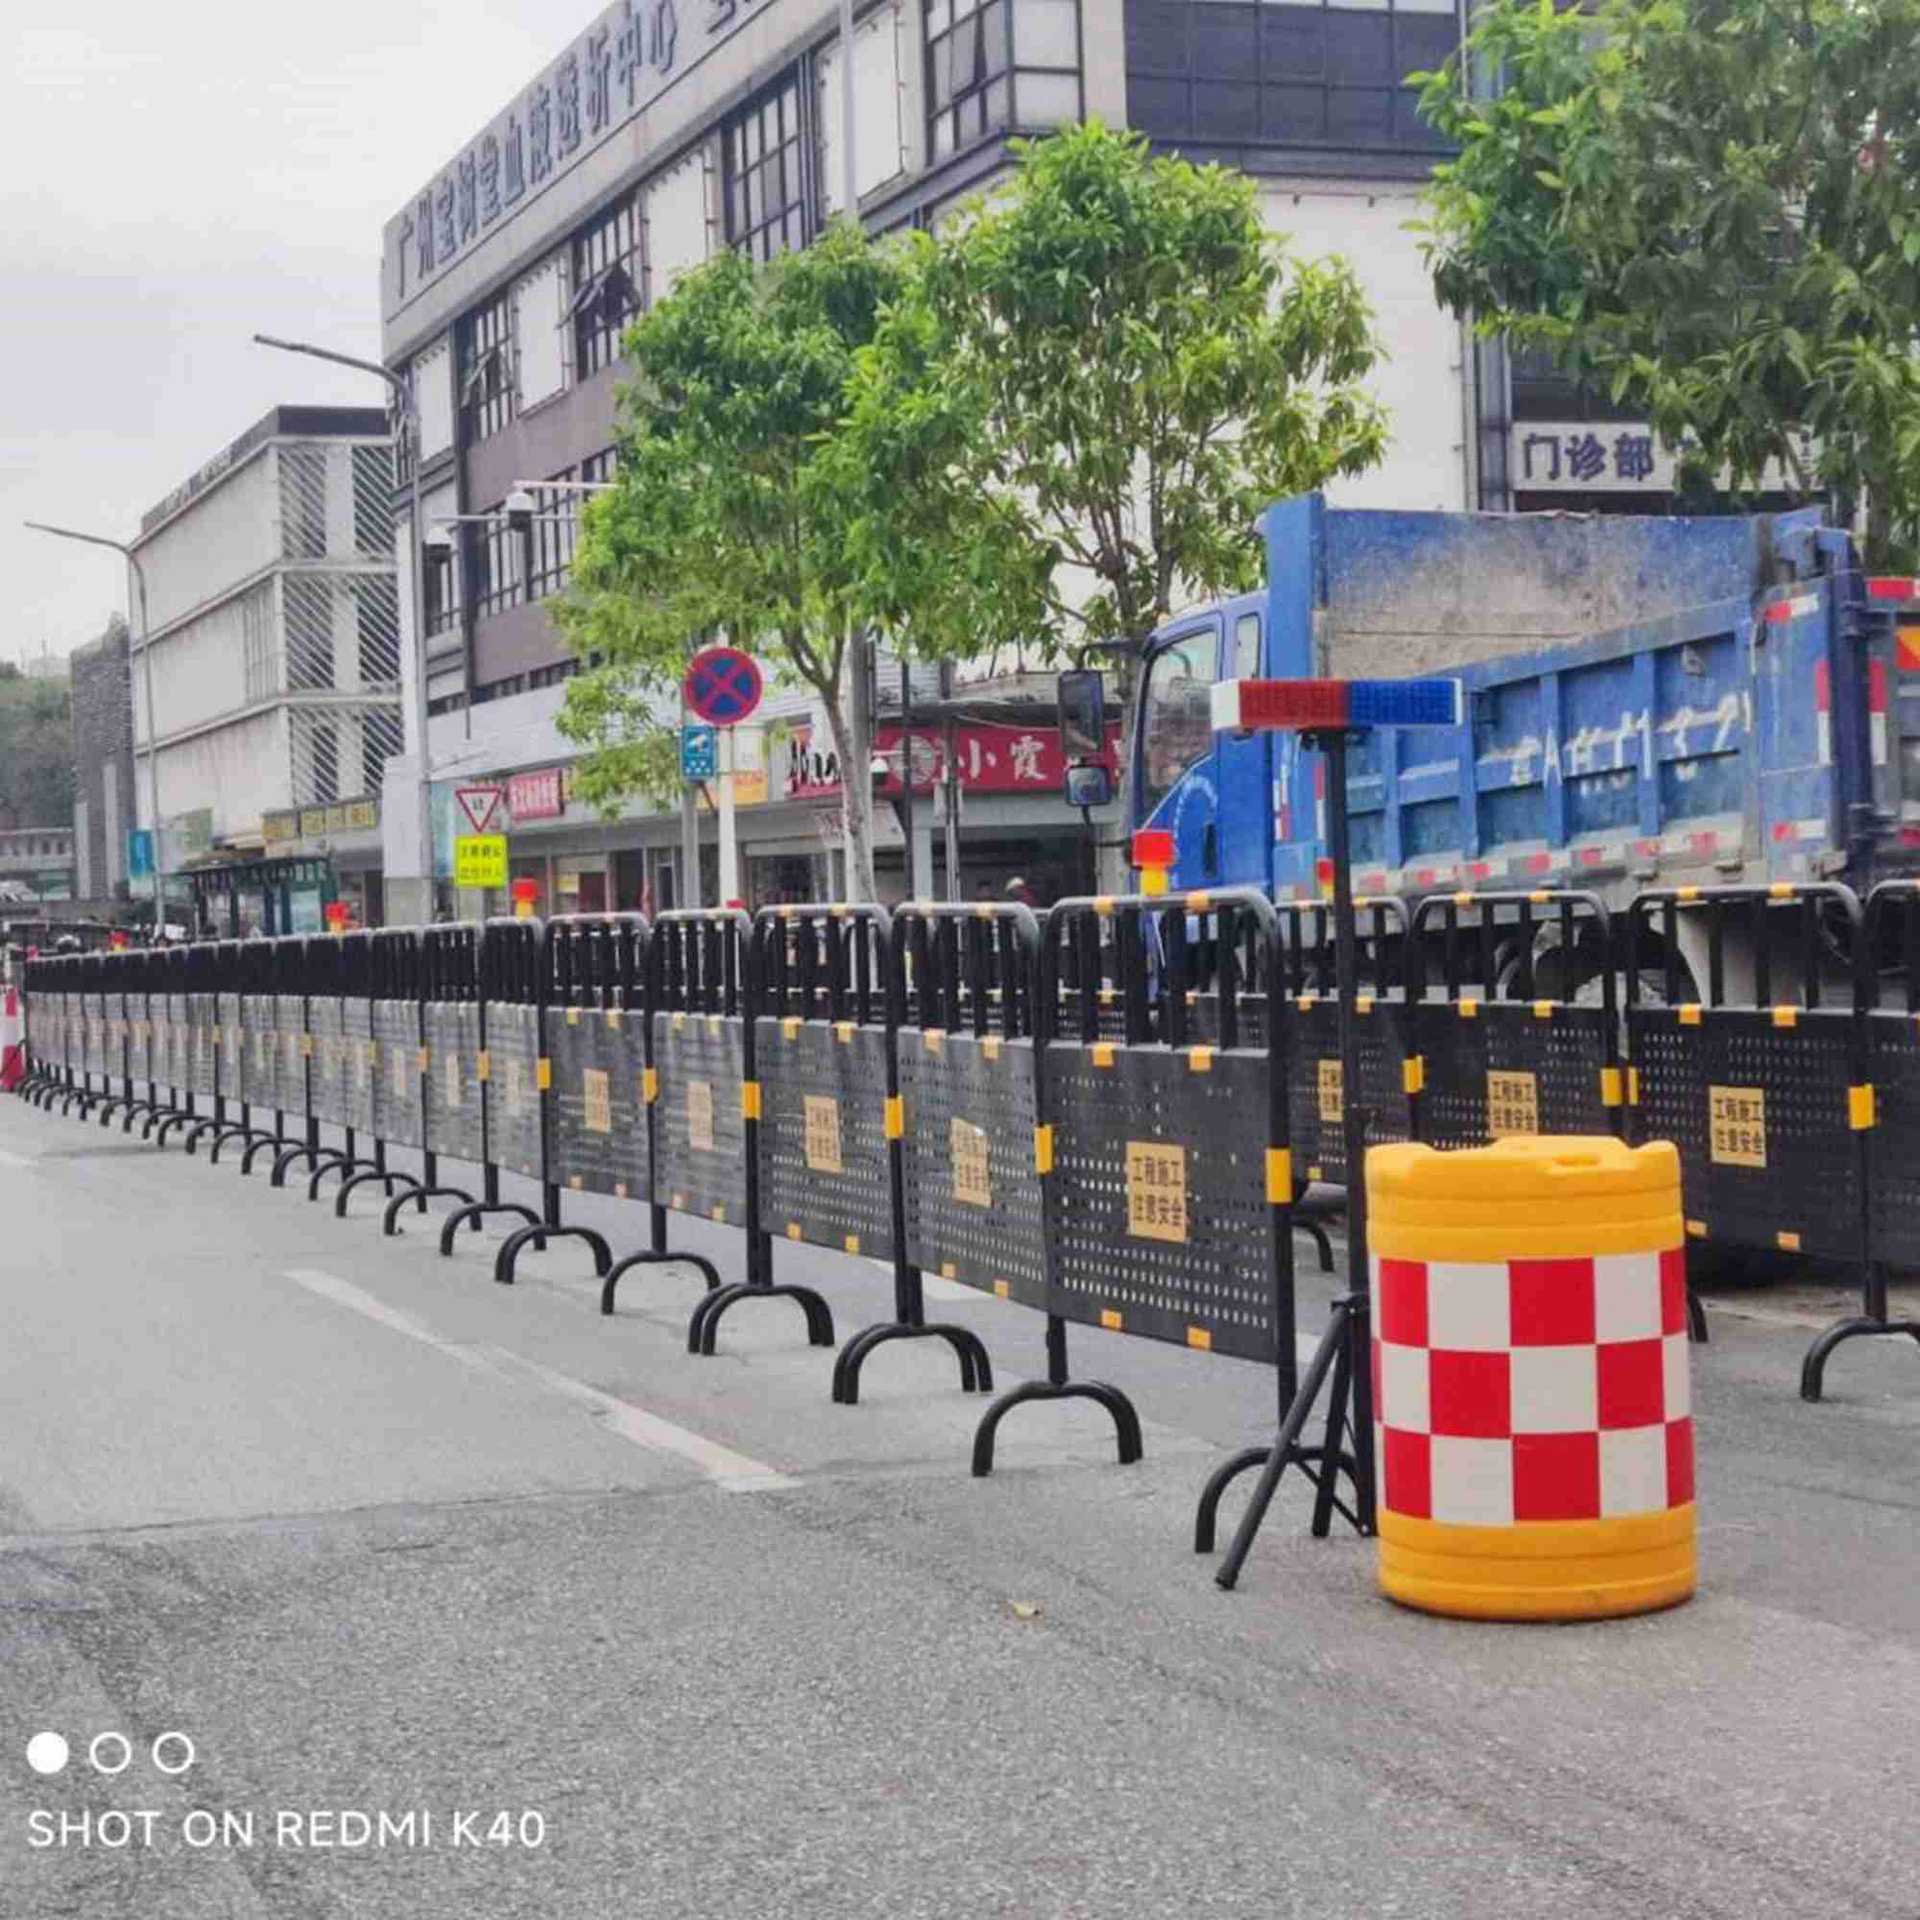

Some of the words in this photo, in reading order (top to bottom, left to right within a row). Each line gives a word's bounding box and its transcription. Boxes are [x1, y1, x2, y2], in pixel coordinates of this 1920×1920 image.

[1522, 432, 1655, 482] 门诊部
[1714, 1098, 1762, 1122] 工程施工
[1717, 1128, 1763, 1154] 注意安全
[1132, 1155, 1182, 1187] 工程施工
[1132, 1194, 1183, 1227] 注意安全
